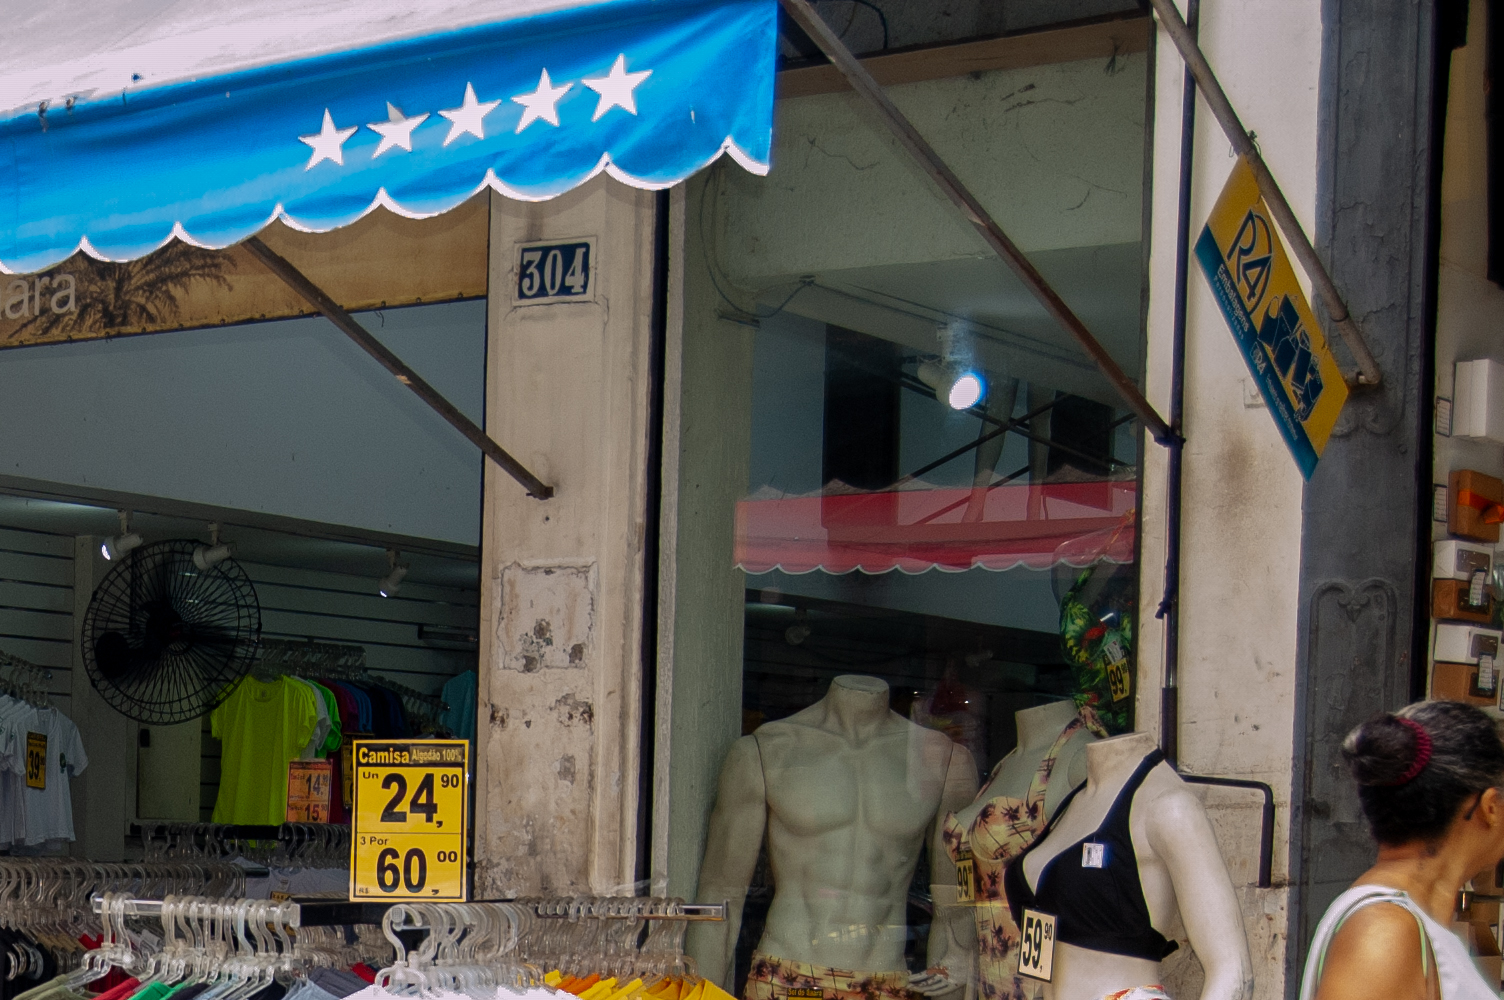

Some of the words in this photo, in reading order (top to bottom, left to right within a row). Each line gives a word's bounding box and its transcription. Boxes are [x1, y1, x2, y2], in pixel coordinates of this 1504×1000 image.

[522, 247, 587, 296] 304
[1217, 263, 1249, 332] Embalagens
[358, 748, 410, 764] Camisa
[411, 749, 440, 763] Algodão
[442, 749, 462, 762] 100%
[360, 837, 366, 845] 3
[370, 837, 389, 845] Por
